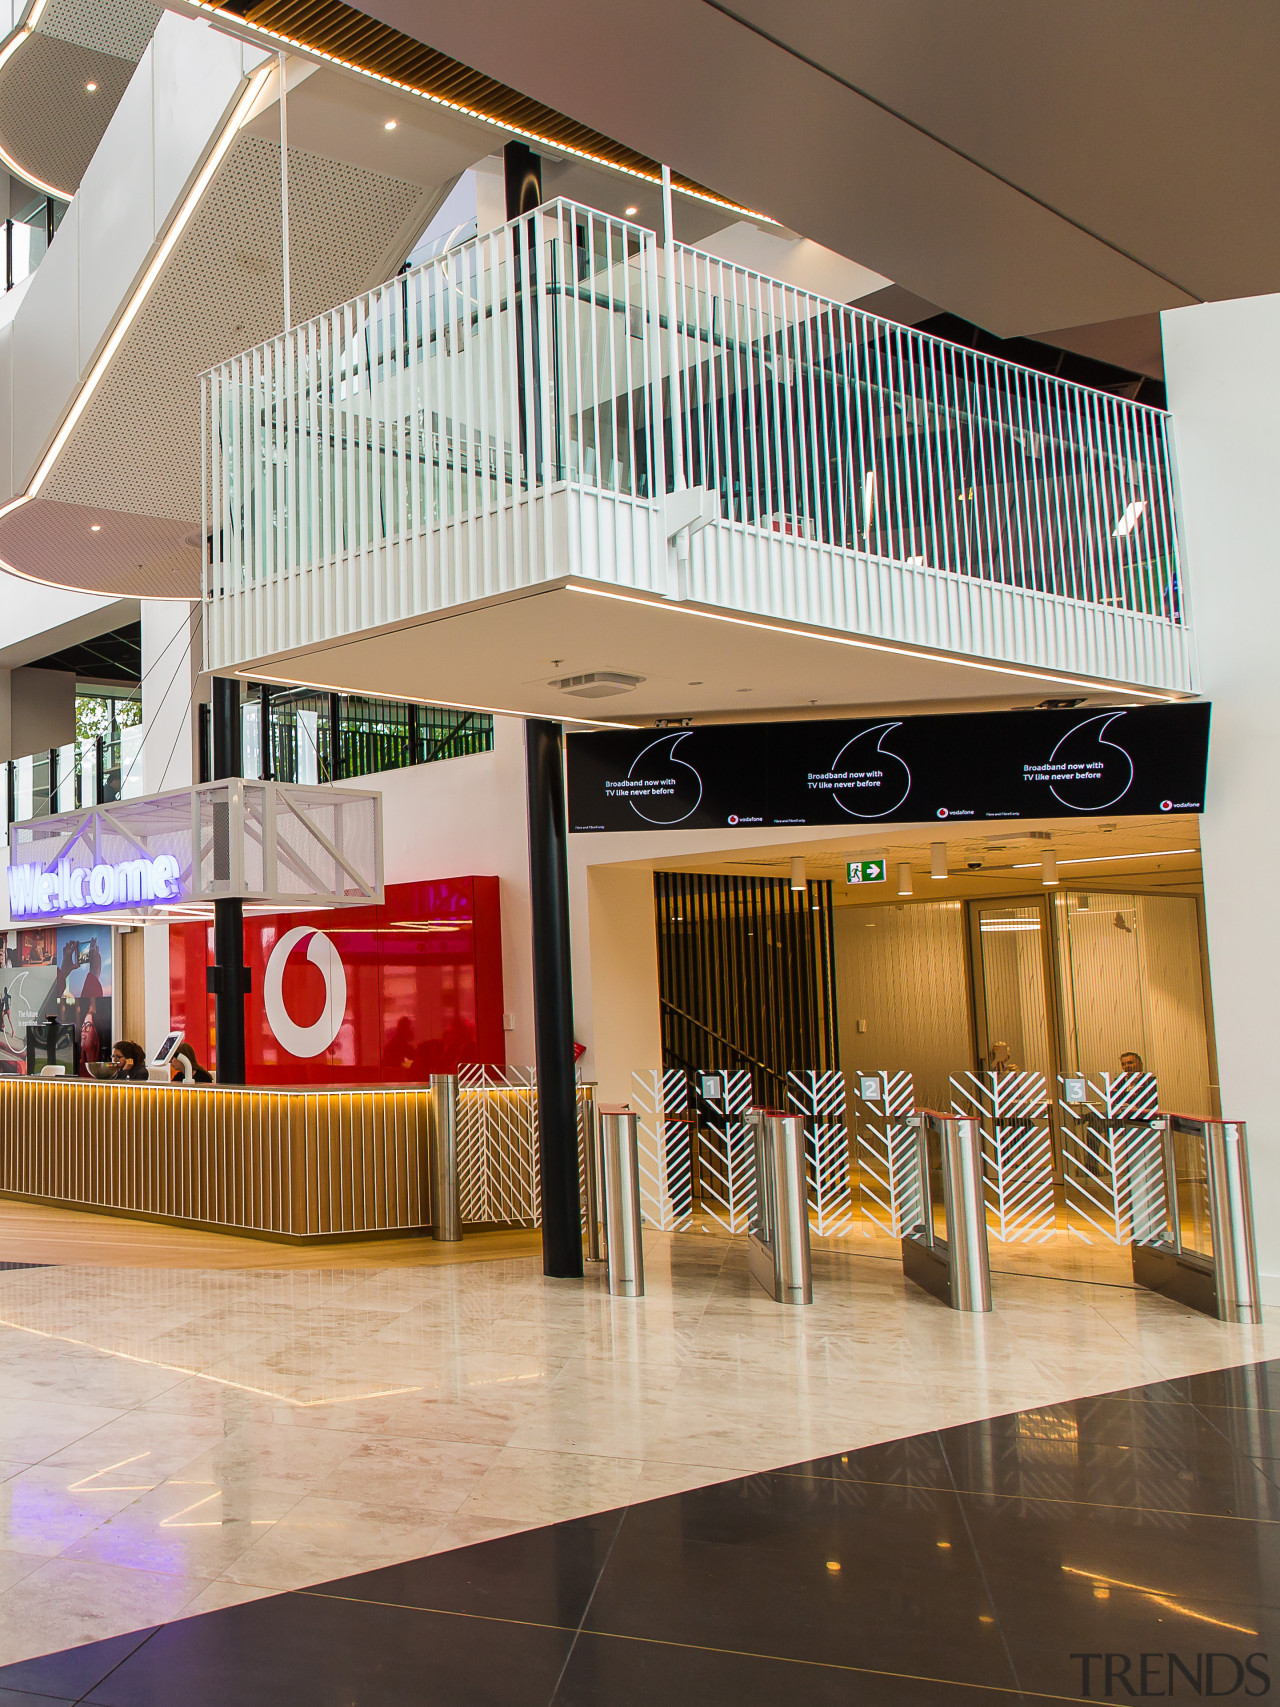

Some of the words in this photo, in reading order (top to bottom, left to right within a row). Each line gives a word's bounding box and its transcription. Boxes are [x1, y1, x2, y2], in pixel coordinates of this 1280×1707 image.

[1023, 762, 1067, 772] Broadband
[1067, 763, 1085, 771] now
[1085, 761, 1105, 770] with
[807, 771, 848, 780] Broadband
[866, 769, 883, 778] with
[1023, 773, 1034, 781] TV
[1034, 773, 1050, 781] like
[1075, 771, 1102, 780] before
[605, 779, 643, 788] Broadband
[660, 778, 676, 786] with
[807, 781, 818, 789] TV
[818, 781, 833, 789] like
[833, 781, 855, 789] never
[856, 779, 882, 788] before
[605, 789, 615, 797] TV
[615, 789, 629, 797] like
[651, 787, 675, 796] before
[7, 854, 182, 916] Welcome
[706, 1079, 716, 1096] 1
[864, 1080, 877, 1097] 2
[1070, 1082, 1083, 1098] 3
